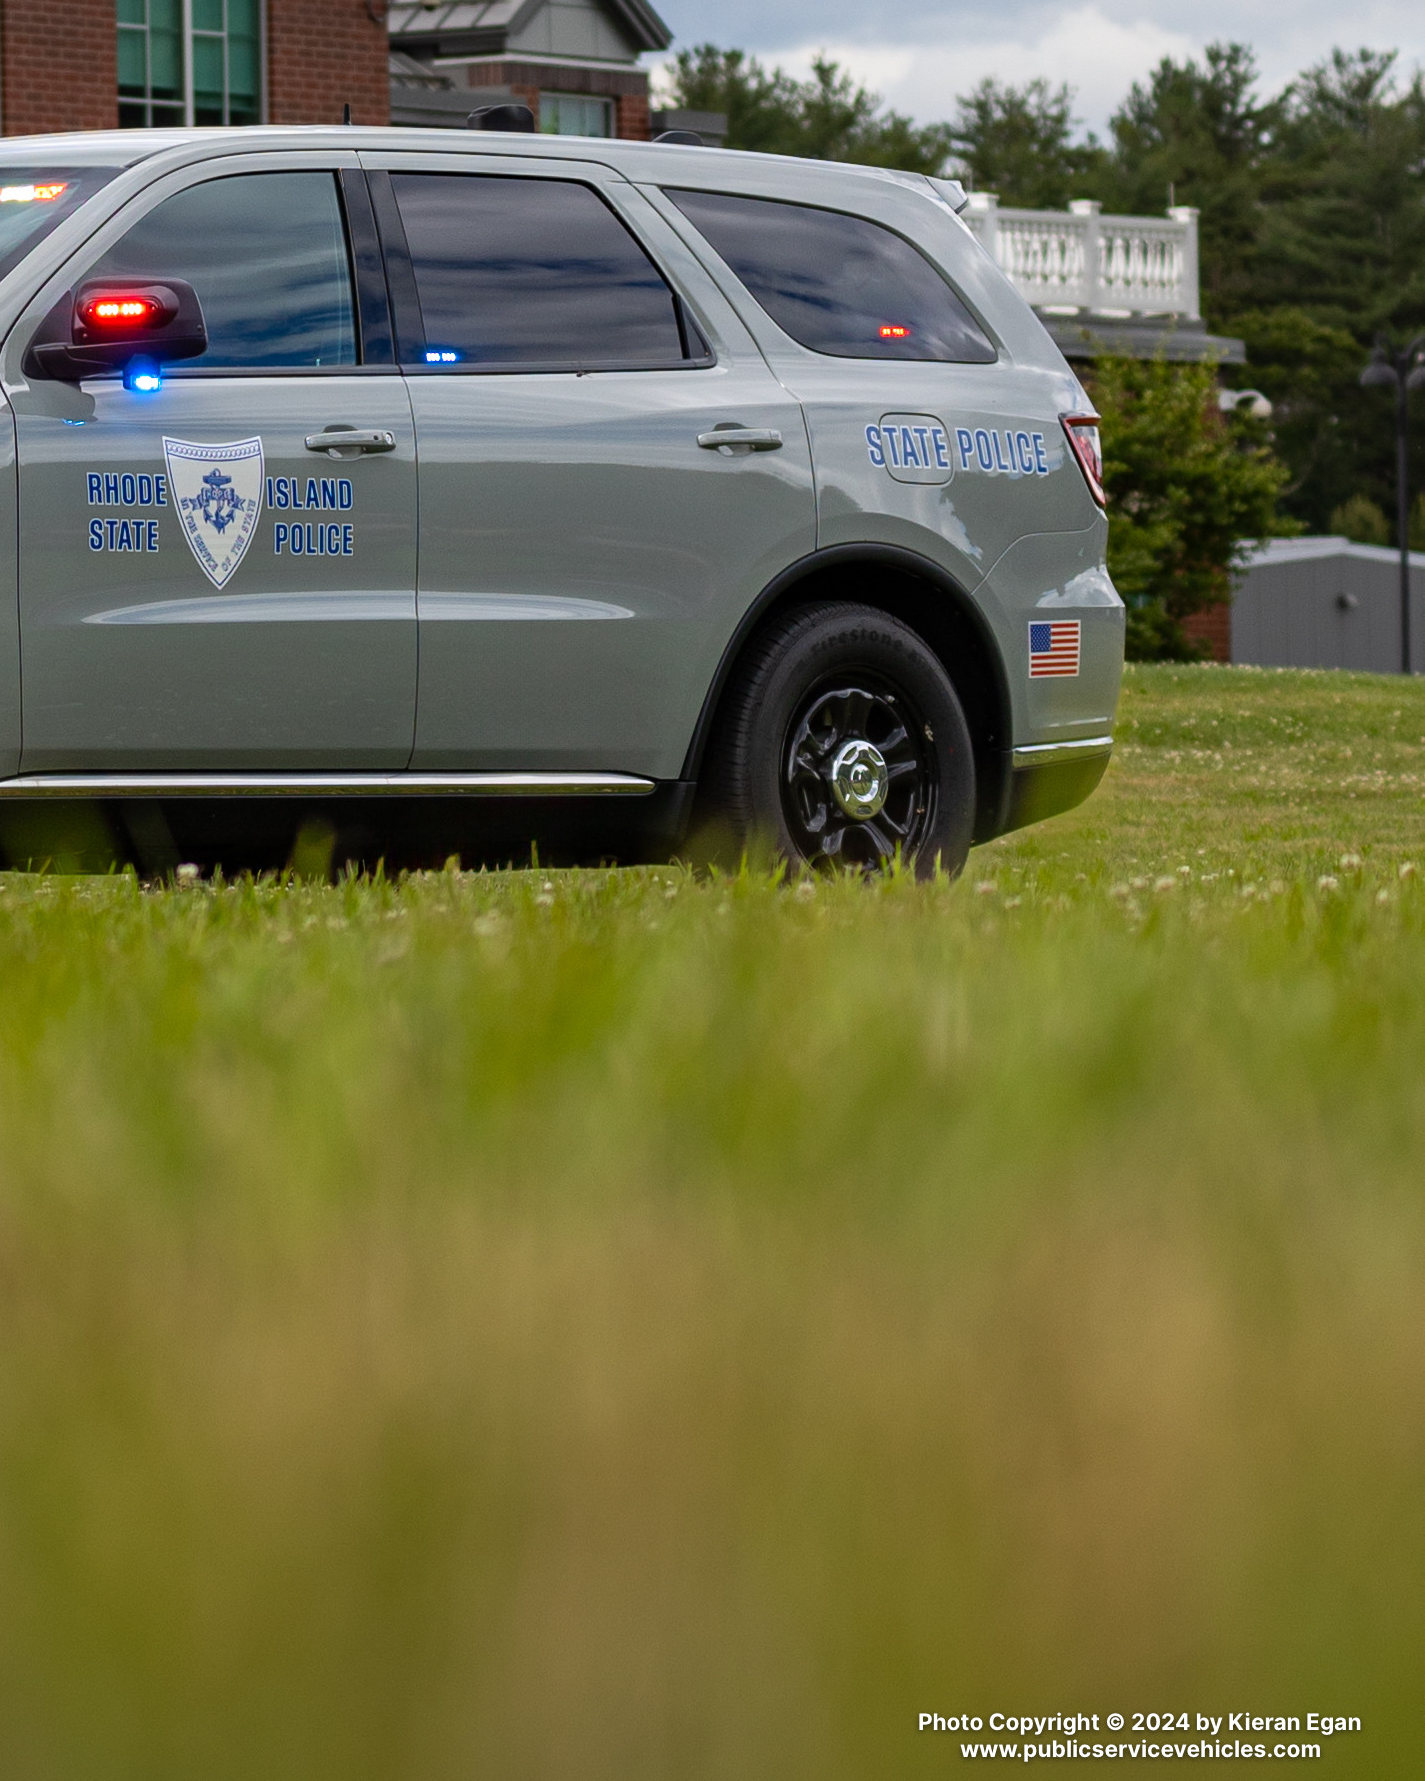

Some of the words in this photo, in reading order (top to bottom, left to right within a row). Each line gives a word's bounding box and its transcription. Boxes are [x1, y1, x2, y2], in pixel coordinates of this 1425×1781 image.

[865, 424, 950, 469] STATE
[956, 428, 1049, 475] POLICE
[87, 472, 168, 507] RHODE
[266, 477, 353, 511] ISLAND
[89, 518, 159, 552] STATE
[274, 522, 353, 556] POLICE
